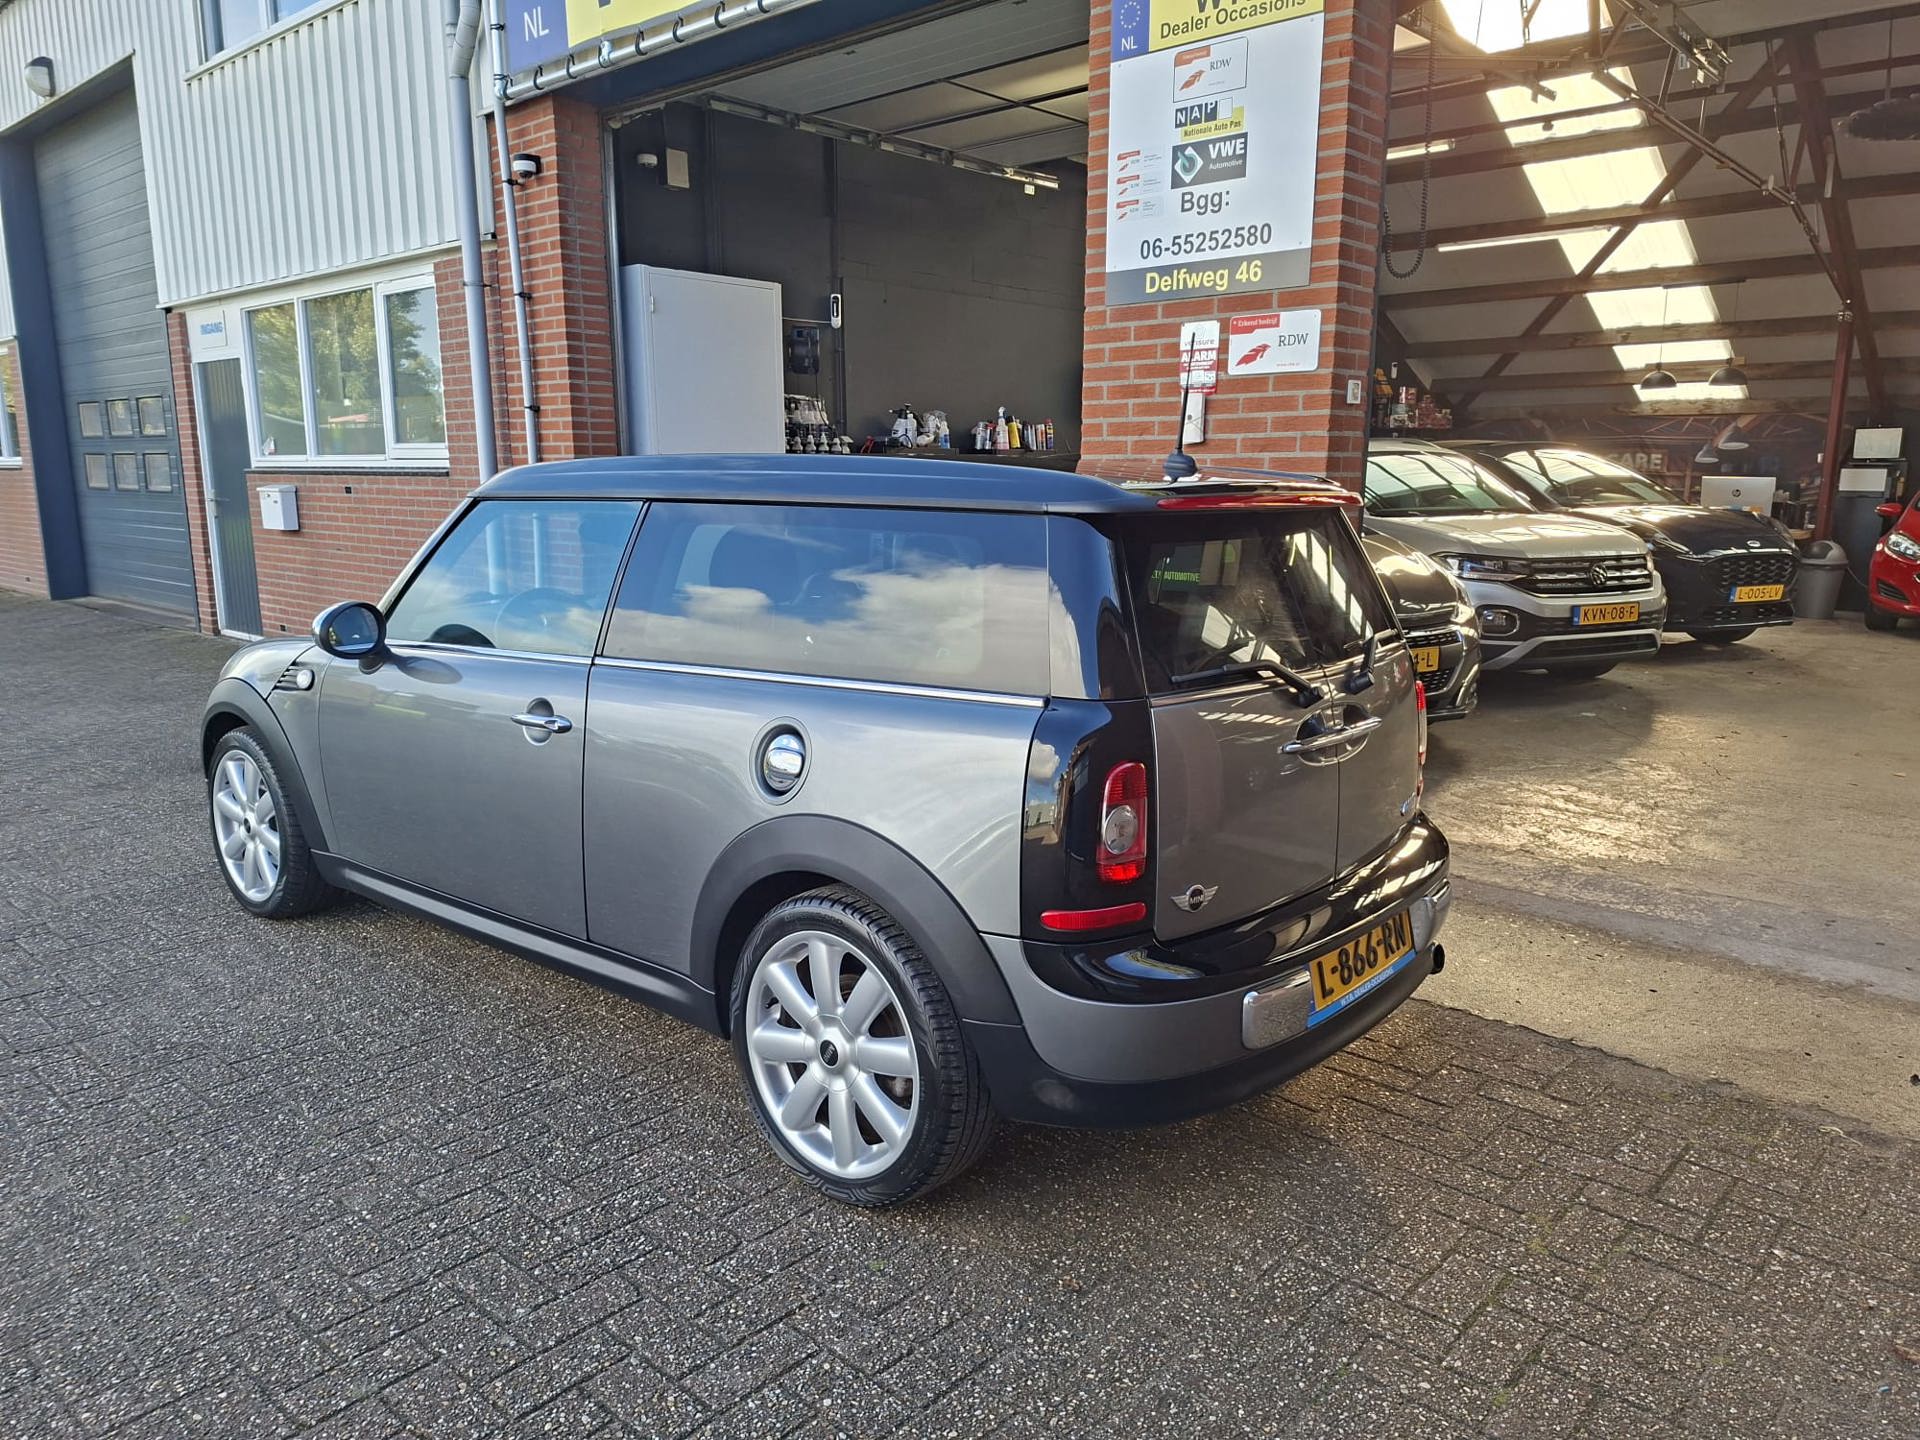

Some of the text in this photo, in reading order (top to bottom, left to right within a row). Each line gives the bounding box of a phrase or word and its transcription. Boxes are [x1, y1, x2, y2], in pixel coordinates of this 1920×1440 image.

[524, 7, 549, 42] NL
[1161, 15, 1211, 39] Dealer
[1121, 36, 1138, 51] NL
[1209, 57, 1232, 71] RDW
[1176, 100, 1216, 125] NAP
[1184, 126, 1213, 137] Nationale
[1214, 123, 1228, 132] Auto
[1208, 138, 1245, 159] VWE
[1209, 159, 1243, 170] Automotive
[1180, 189, 1231, 215] Bgg:
[1140, 222, 1273, 260] 06-55252580
[1145, 259, 1263, 294] Delfweg 46
[1278, 333, 1309, 347] RDW
[1164, 570, 1200, 583] AUTOMOTIVE
[1738, 586, 1781, 600] L-005-LV
[1582, 605, 1636, 622] KVN-08-F
[1317, 911, 1407, 1000] L-866-RN
